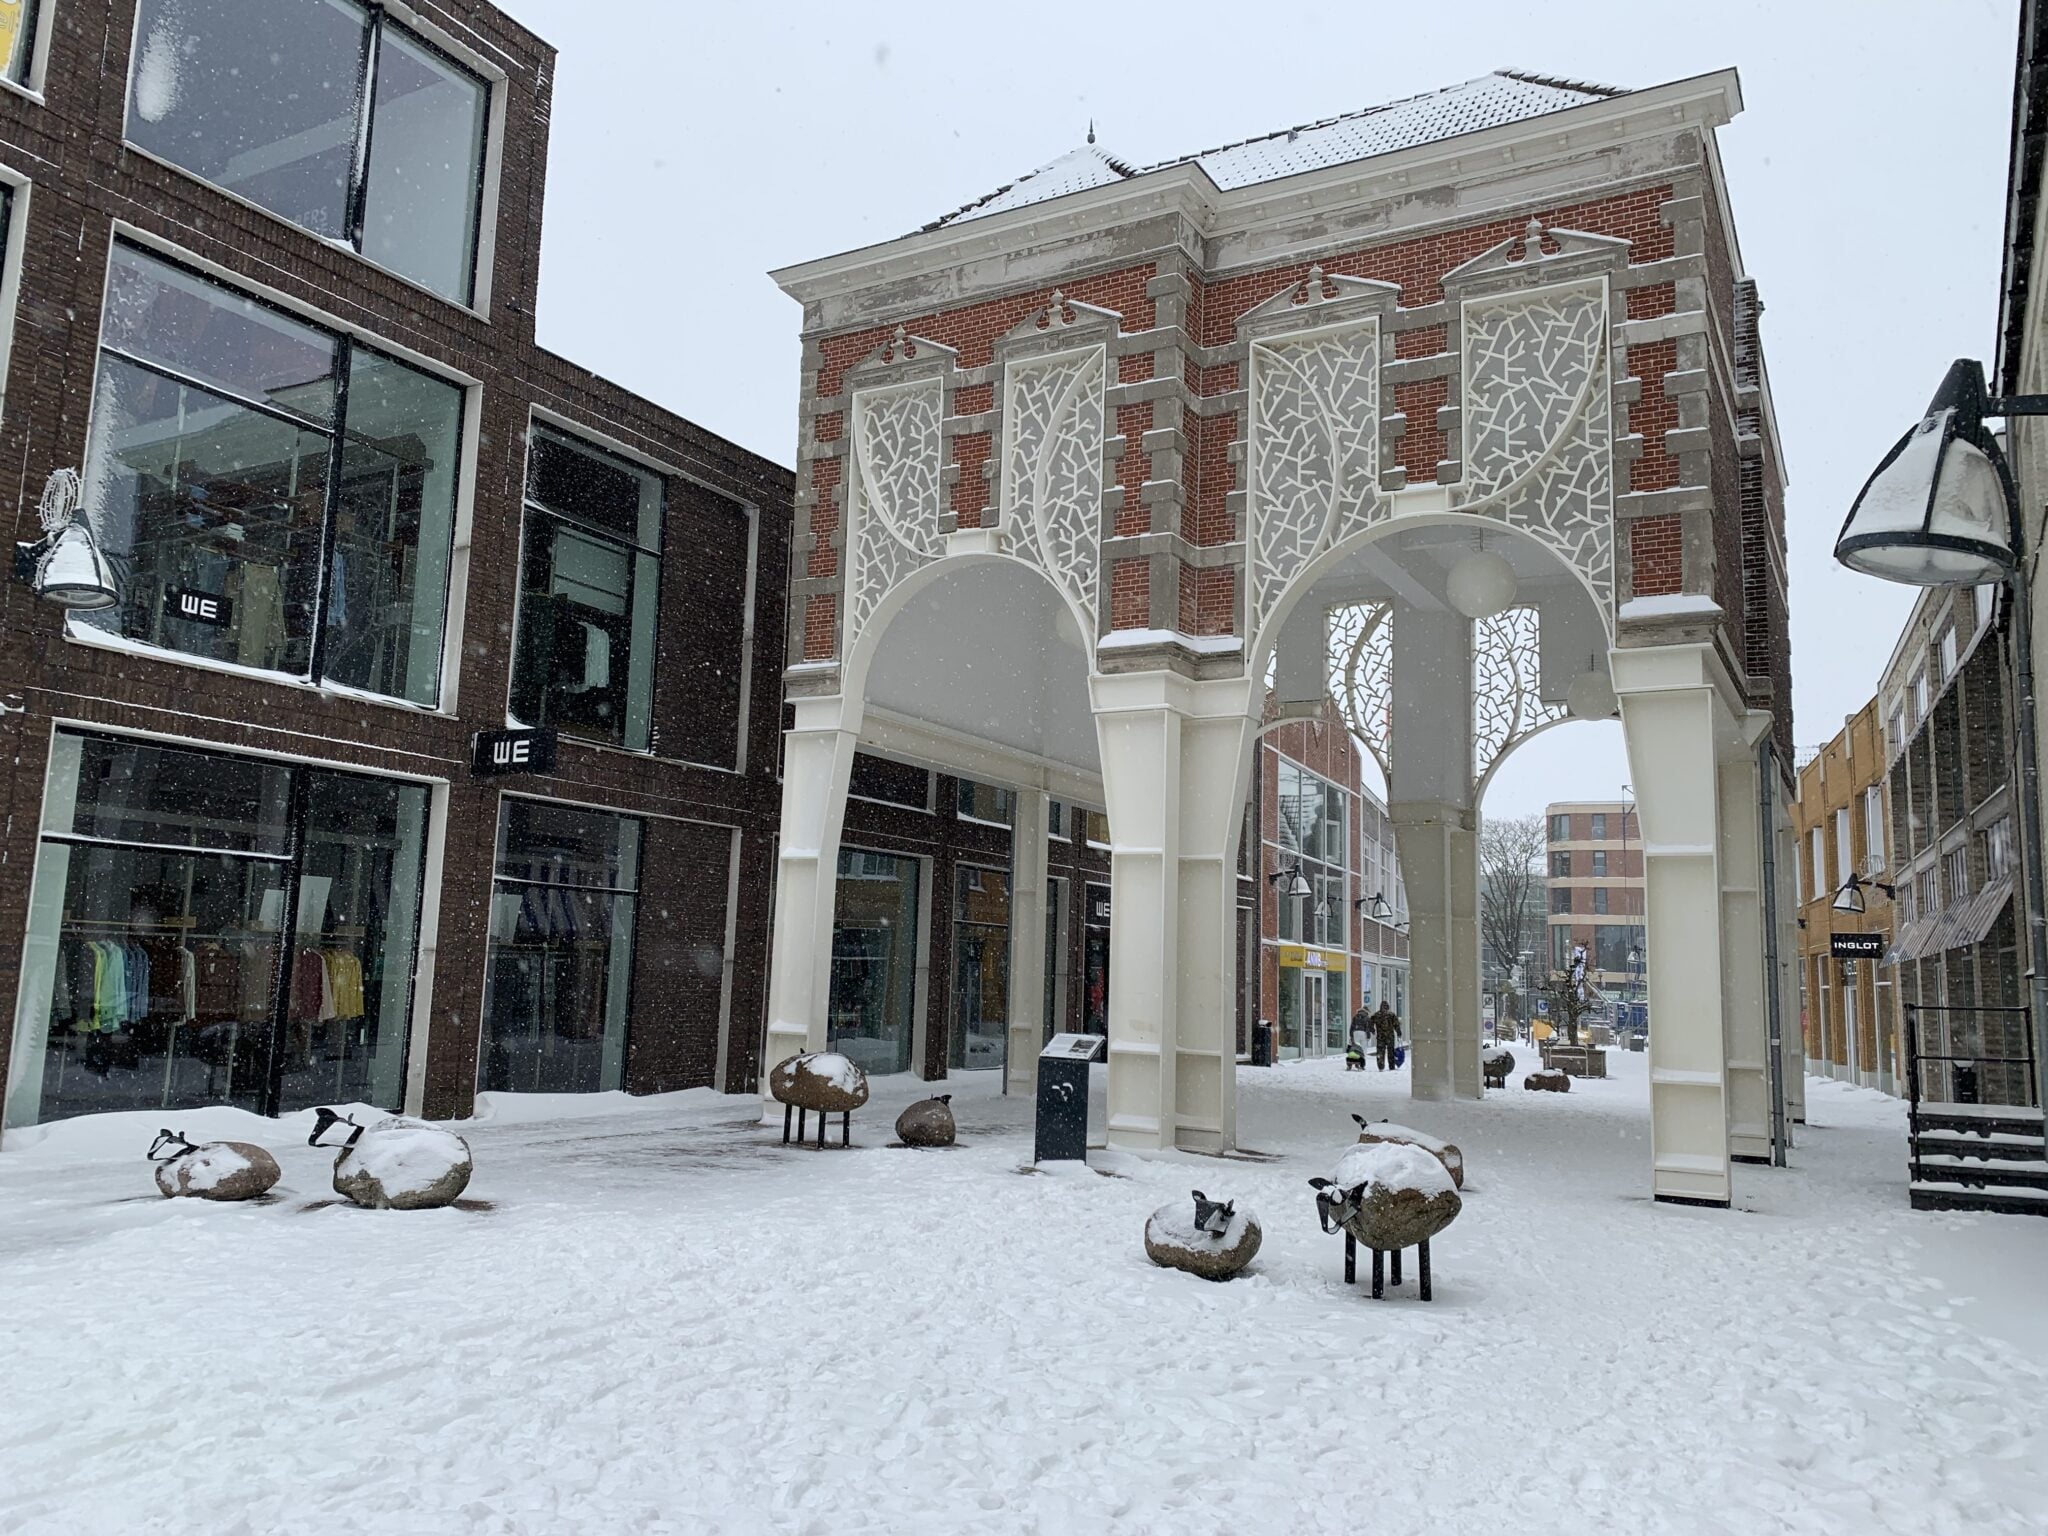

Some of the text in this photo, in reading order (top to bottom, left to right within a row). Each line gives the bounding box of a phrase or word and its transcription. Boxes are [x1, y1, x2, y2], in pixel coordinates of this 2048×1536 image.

[181, 594, 218, 619] WE
[493, 739, 530, 764] WE
[1096, 901, 1111, 918] WE
[1834, 942, 1879, 950] INGLOT
